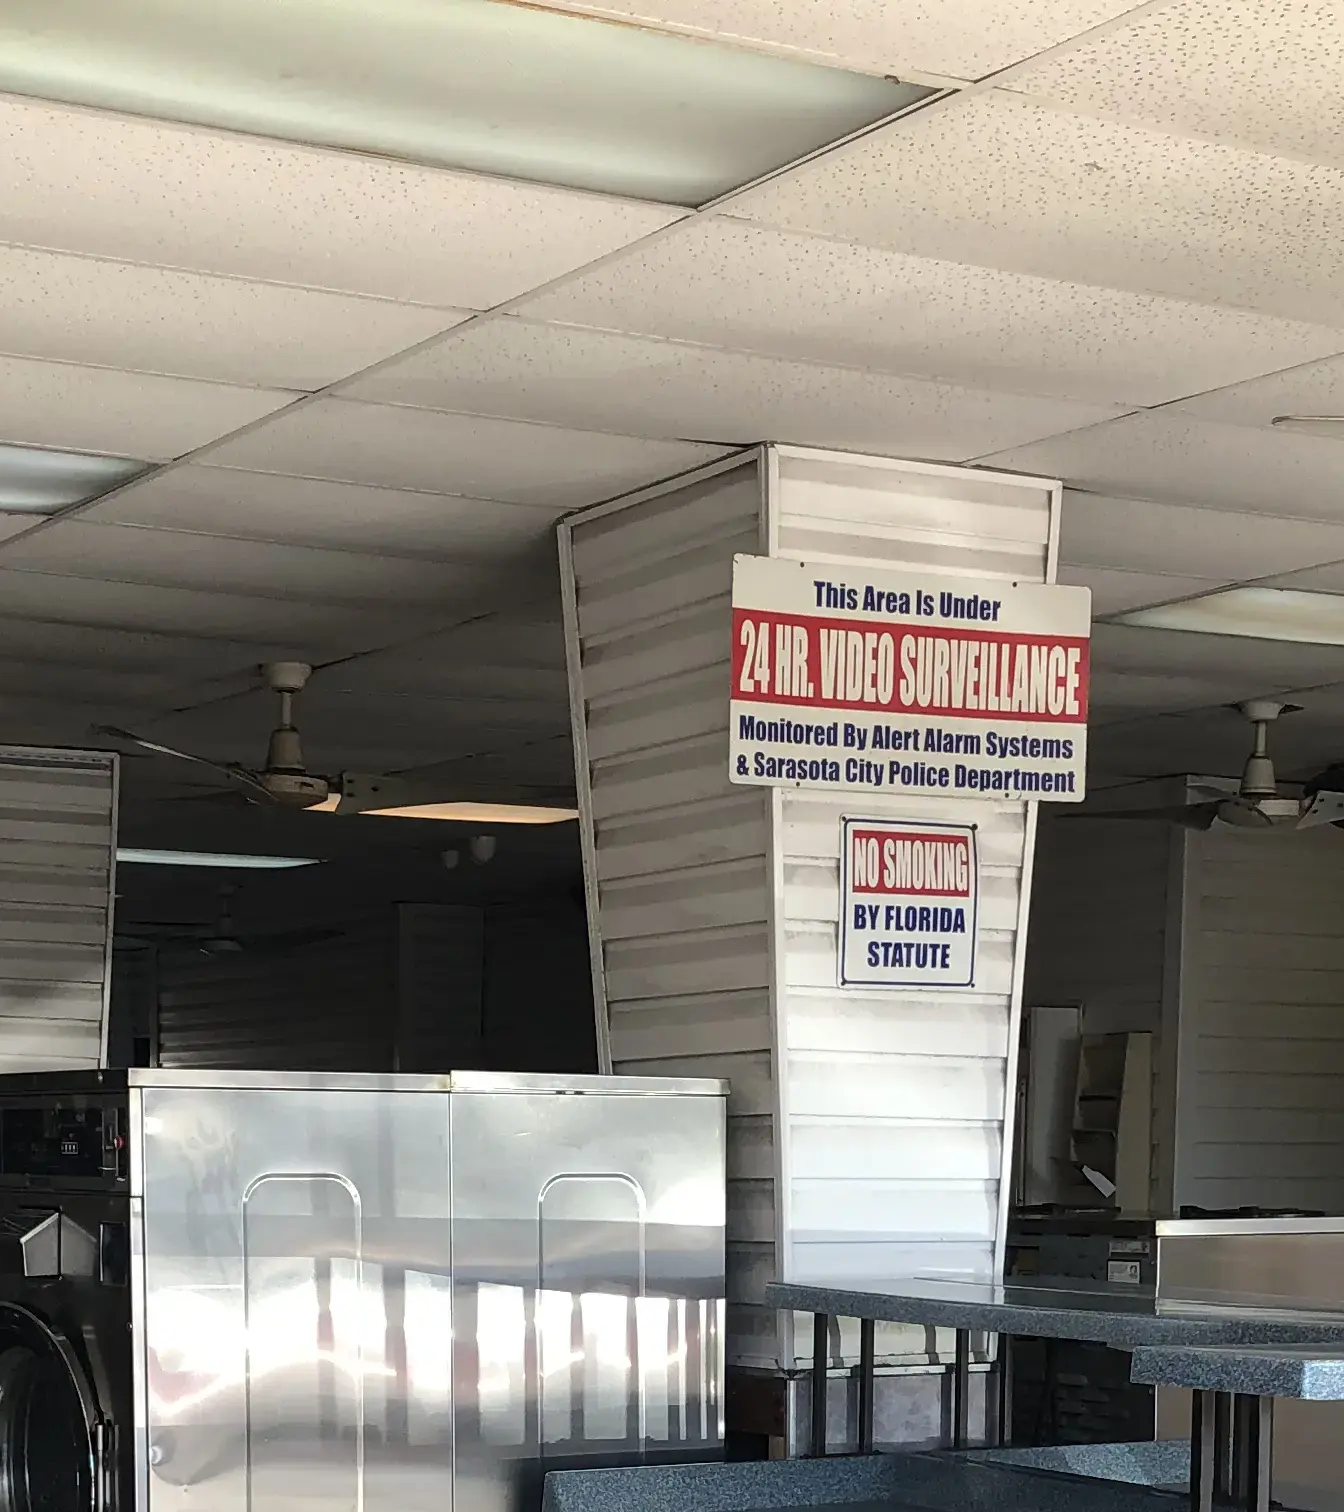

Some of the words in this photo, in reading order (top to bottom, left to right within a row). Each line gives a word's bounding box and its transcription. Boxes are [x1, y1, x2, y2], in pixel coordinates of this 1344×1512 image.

[813, 580, 858, 610] This
[862, 585, 911, 614] Area
[915, 590, 934, 616] Is
[940, 592, 1001, 621] Under
[740, 619, 770, 694] 24
[775, 623, 814, 698] HR.
[819, 628, 895, 705] VIDEO
[900, 634, 1080, 715] SURVEILLANCE
[739, 715, 838, 747] Monitored
[843, 723, 868, 750] By
[872, 725, 920, 752] Alert
[924, 728, 981, 755] Alarm
[986, 731, 1074, 759] Systems
[736, 754, 749, 776] &
[754, 752, 840, 782] Sarasota
[845, 758, 884, 786] City
[889, 760, 950, 787] Police
[955, 764, 1076, 792] Department
[855, 837, 879, 888] NO
[883, 839, 968, 891] SMOKING
[854, 904, 880, 930] BY
[885, 905, 965, 933] FLORIDA
[867, 941, 950, 969] STATUTE
